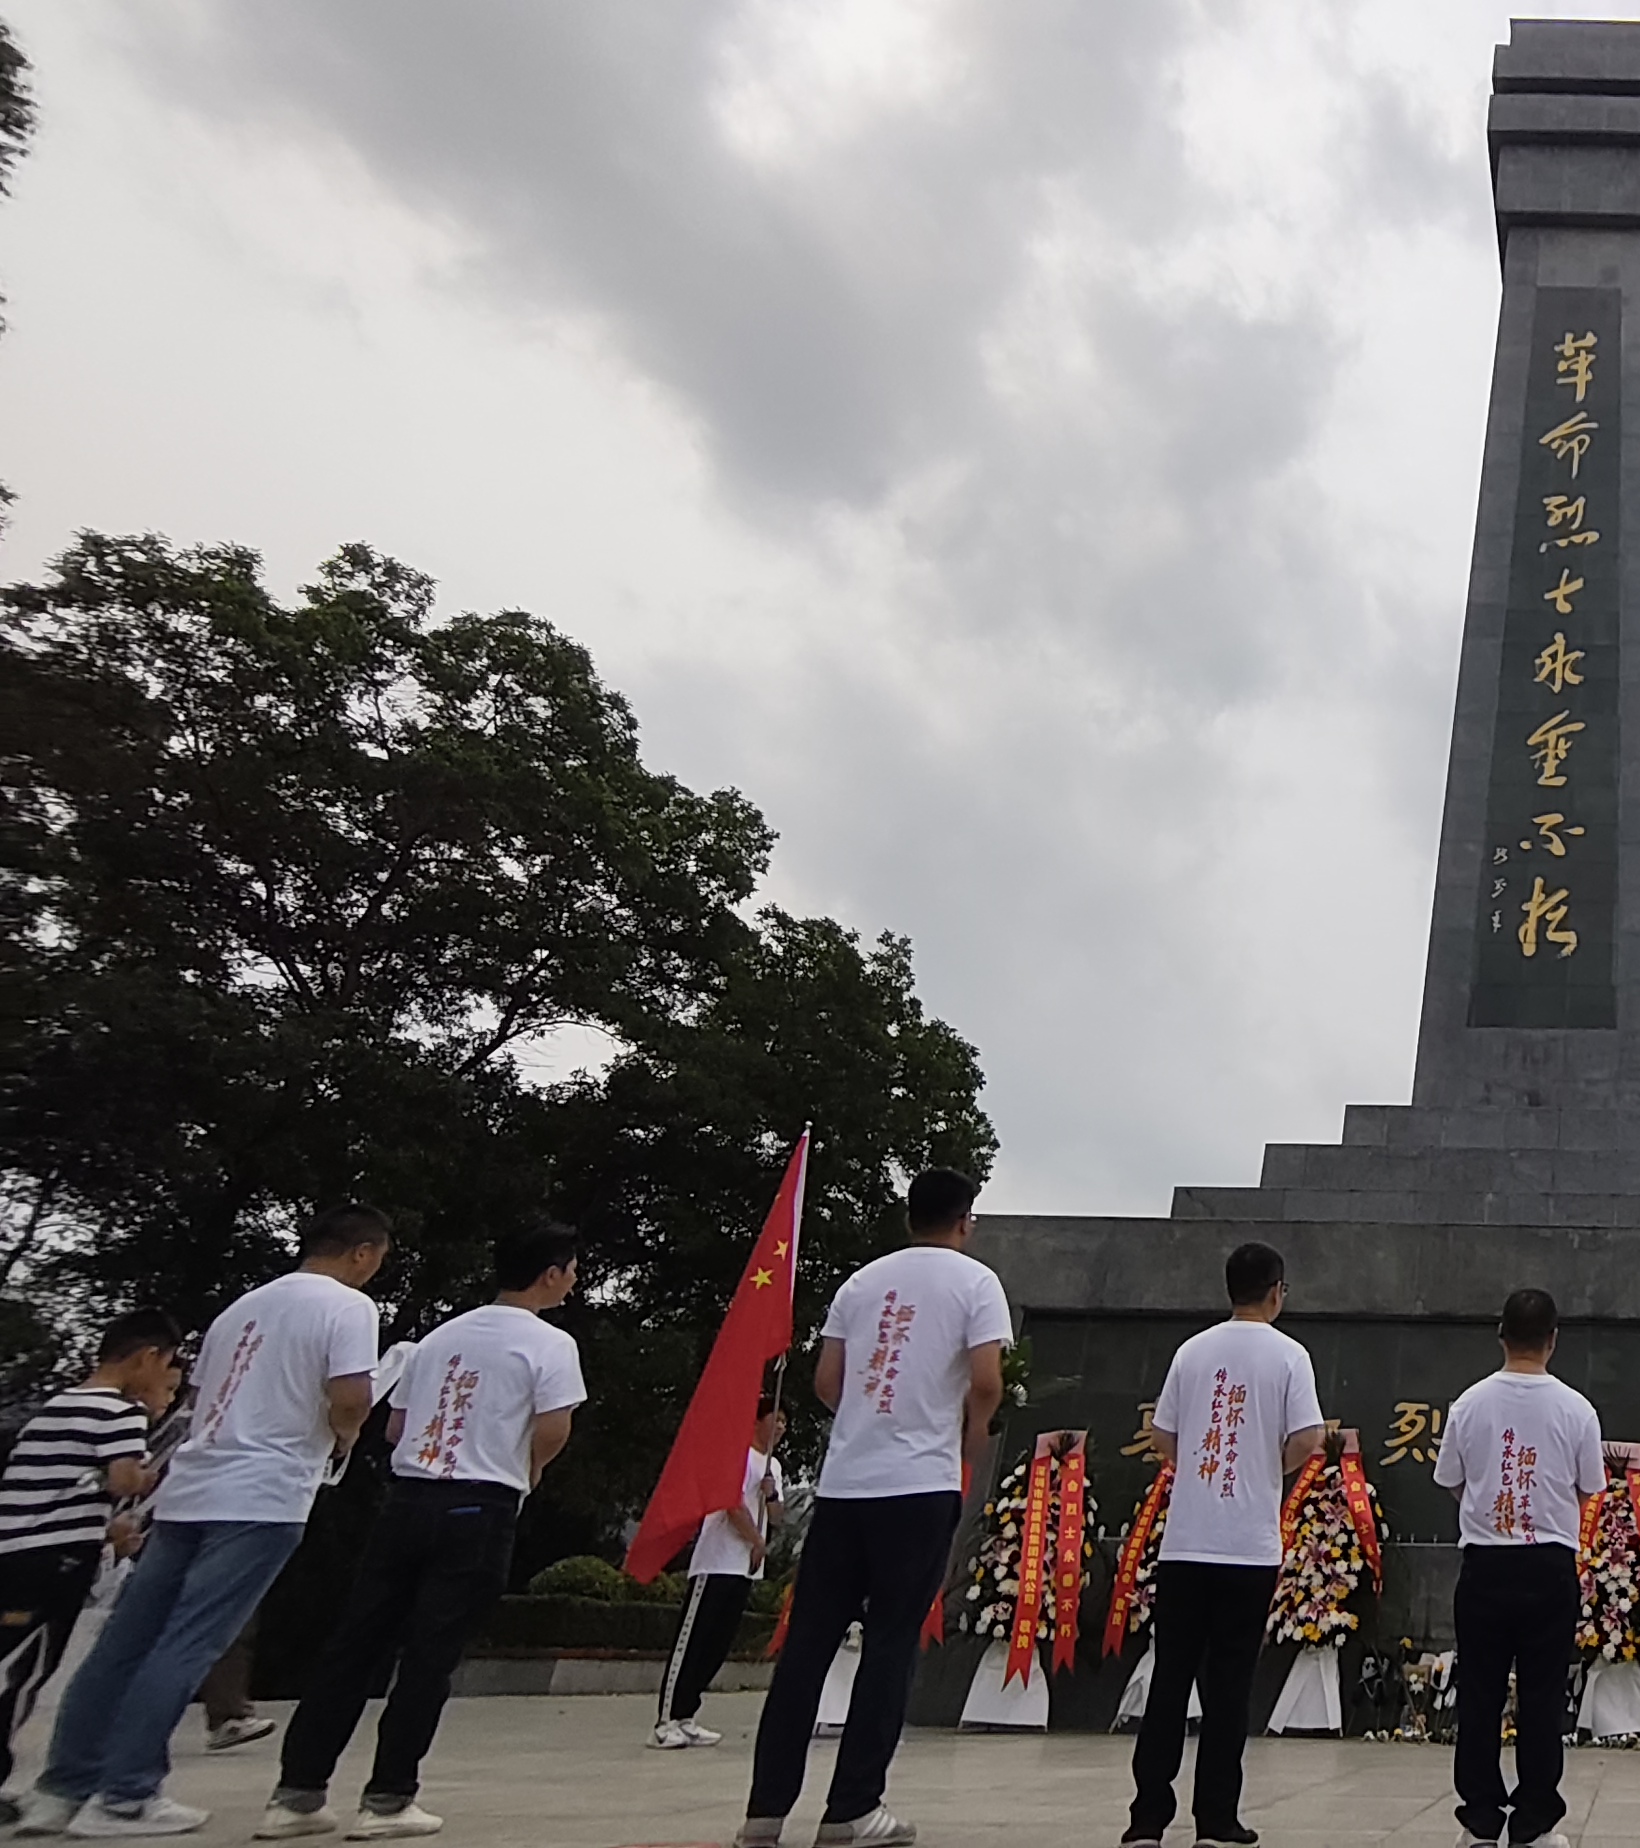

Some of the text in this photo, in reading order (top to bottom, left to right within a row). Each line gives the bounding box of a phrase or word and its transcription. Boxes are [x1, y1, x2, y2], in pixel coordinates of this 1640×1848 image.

[1517, 331, 1600, 959] 革命烈士永垂不朽
[1196, 1367, 1227, 1488] 传承红色精神
[1219, 1383, 1247, 1498] 缅怀革命先烈
[1492, 1427, 1516, 1540] 传承红色精神
